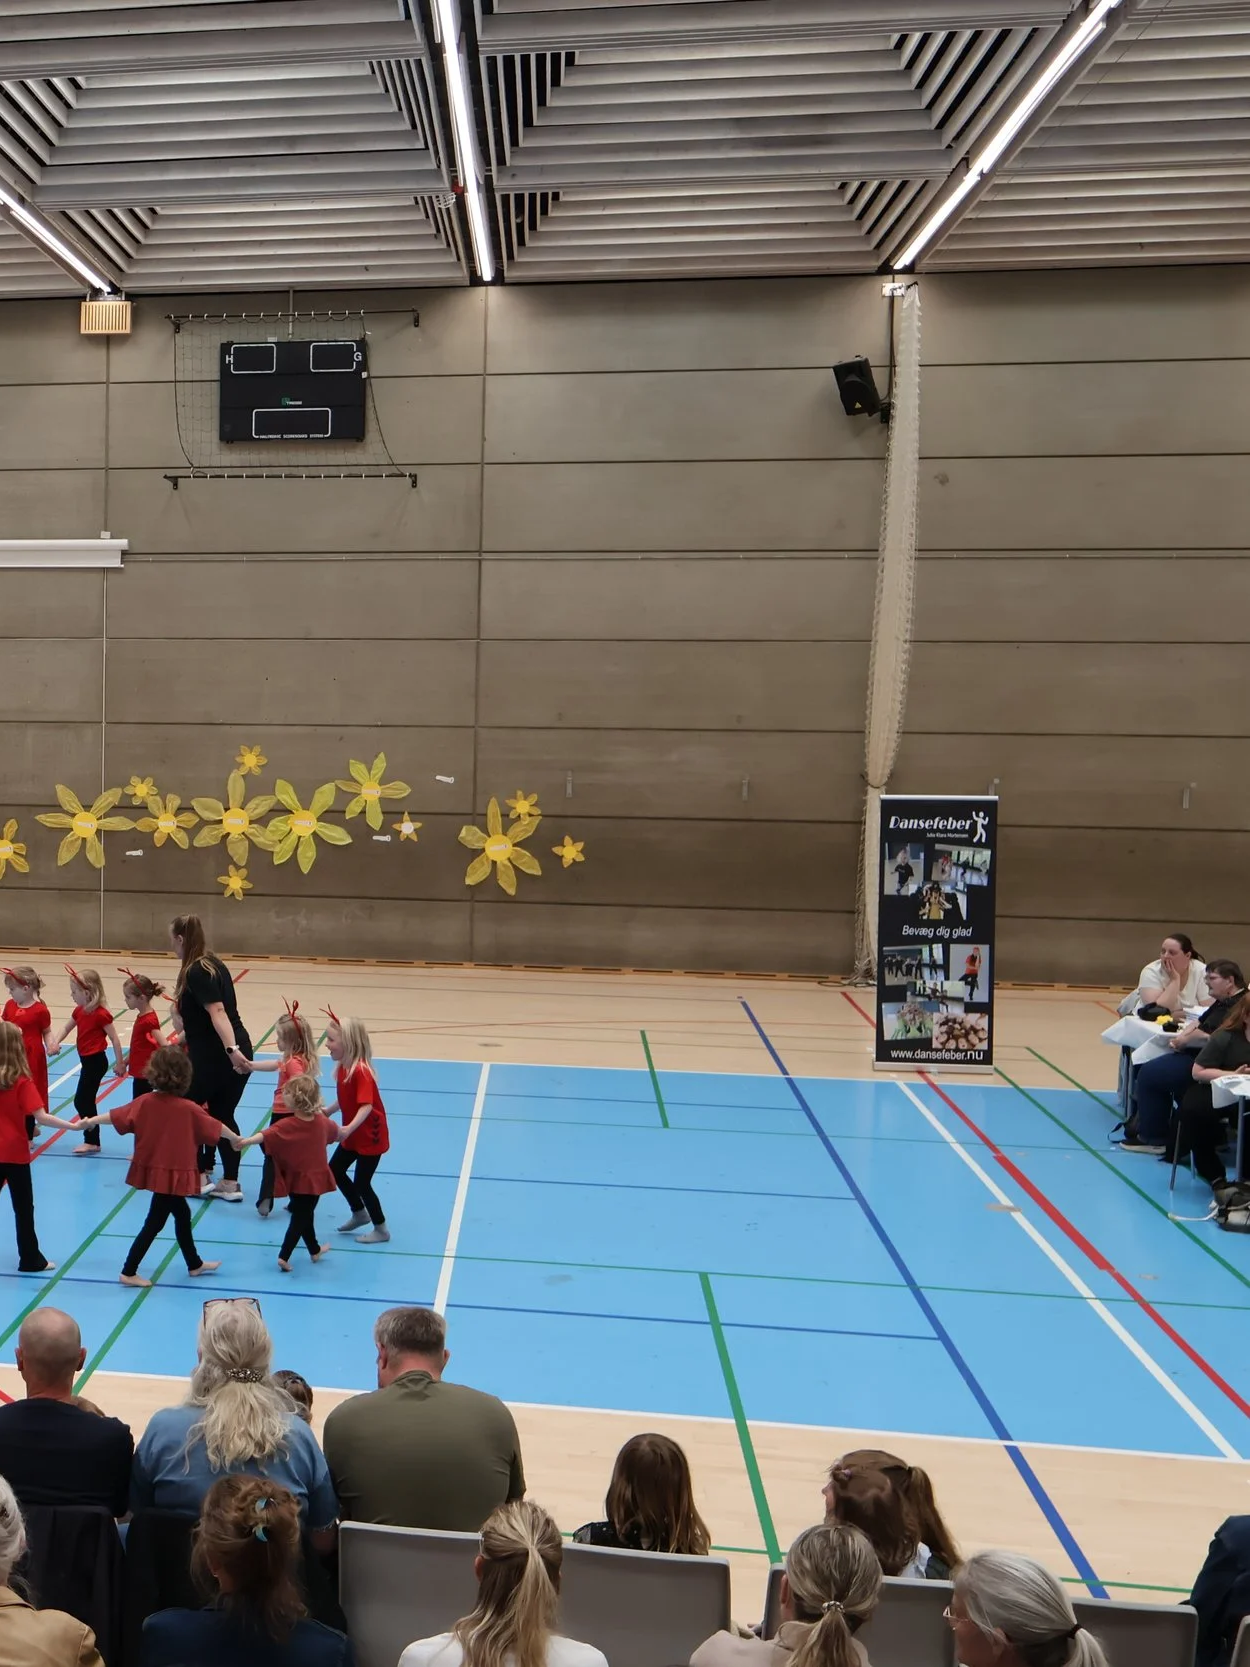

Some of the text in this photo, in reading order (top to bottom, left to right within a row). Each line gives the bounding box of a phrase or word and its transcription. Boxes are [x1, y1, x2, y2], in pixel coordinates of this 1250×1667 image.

[225, 354, 234, 364] H
[353, 351, 363, 362] G
[889, 815, 973, 830] Dansefeber
[902, 925, 973, 939] Bevæg dig glad
[890, 1049, 984, 1061] www.dansefeber.nu
